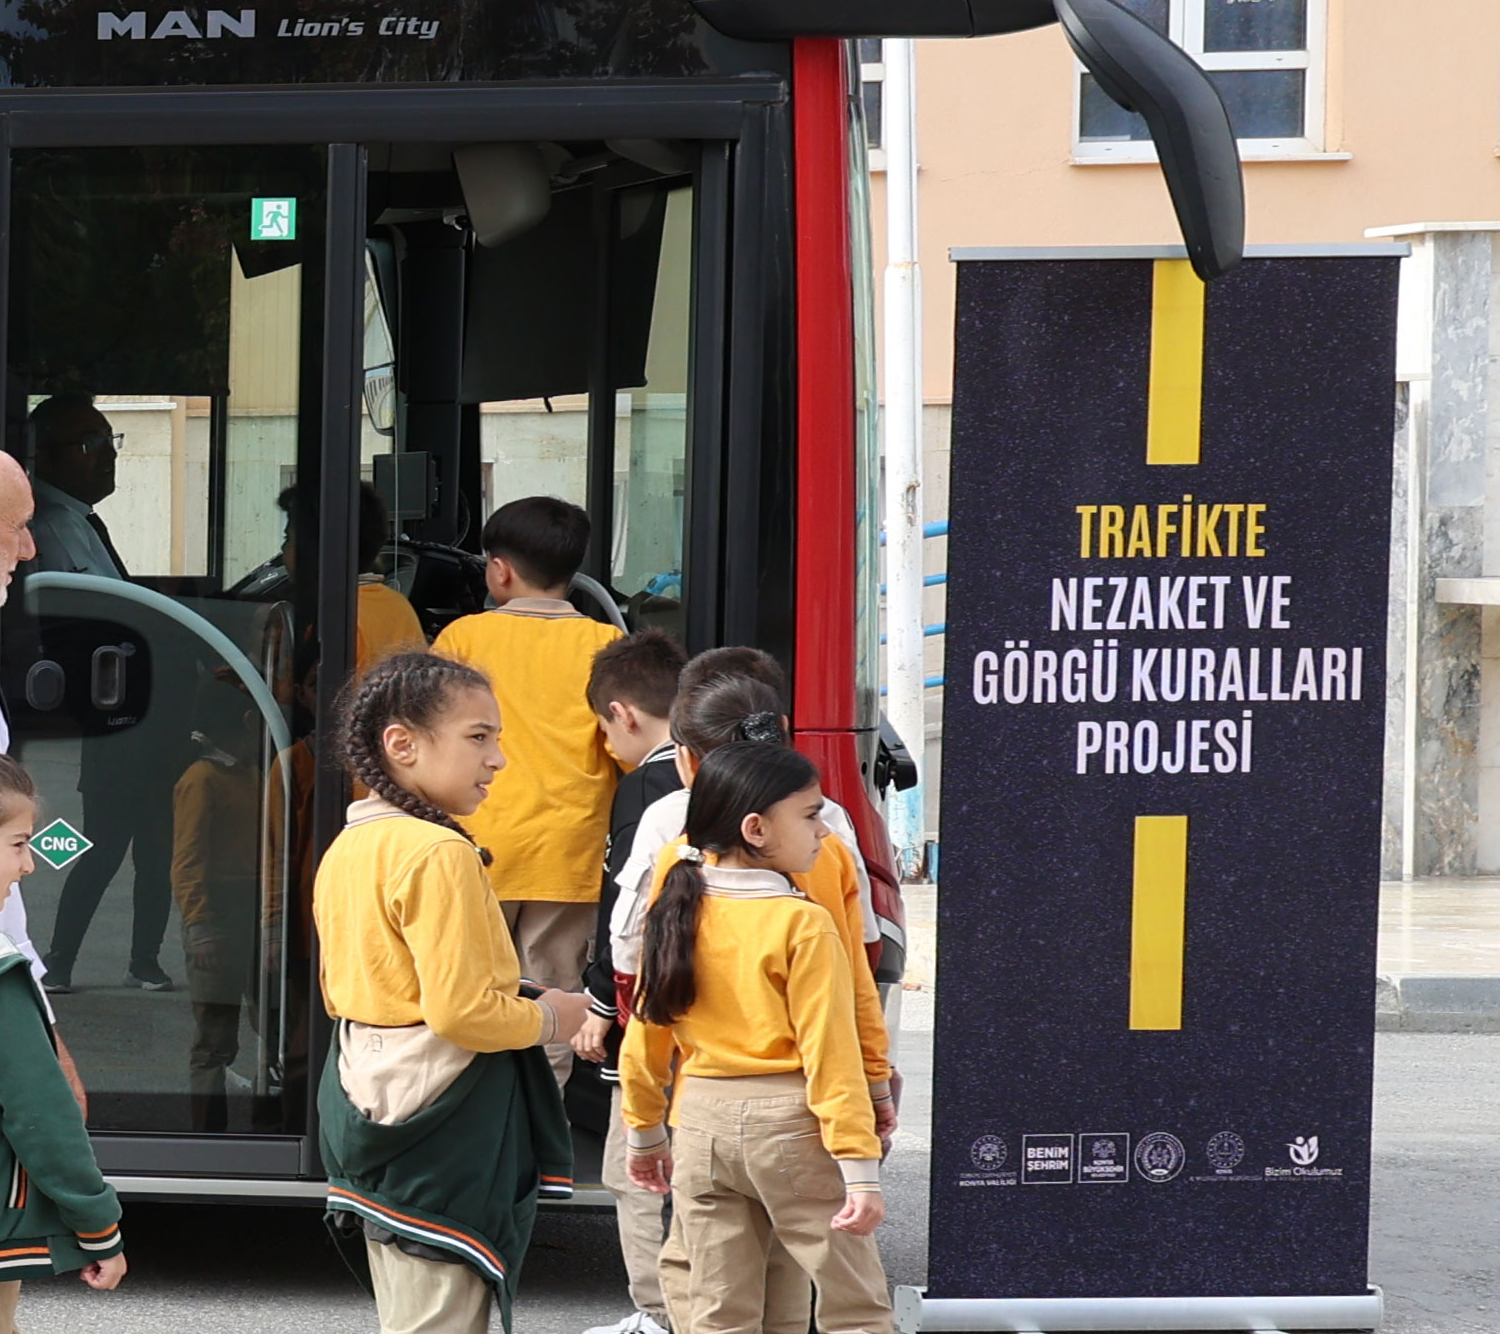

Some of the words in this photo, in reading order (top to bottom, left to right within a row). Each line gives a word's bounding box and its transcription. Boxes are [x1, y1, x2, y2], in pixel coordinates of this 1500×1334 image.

[96, 9, 255, 39] MAN
[278, 16, 364, 40] Lion's
[379, 15, 439, 41] City
[1076, 495, 1266, 559] TRAFİKTE
[1050, 575, 1231, 631] NEZAKET
[1242, 575, 1291, 629] VE
[973, 640, 1120, 704] GÖRGÜ
[1133, 647, 1363, 703] KURALLARI
[1076, 710, 1253, 775] PROJESİ
[41, 837, 78, 851] CNG
[1027, 1147, 1068, 1159] BENİM
[1027, 1160, 1069, 1171] ŞEHRİM
[1265, 1166, 1291, 1176] Bizim
[1293, 1165, 1342, 1176] Okulumuz
